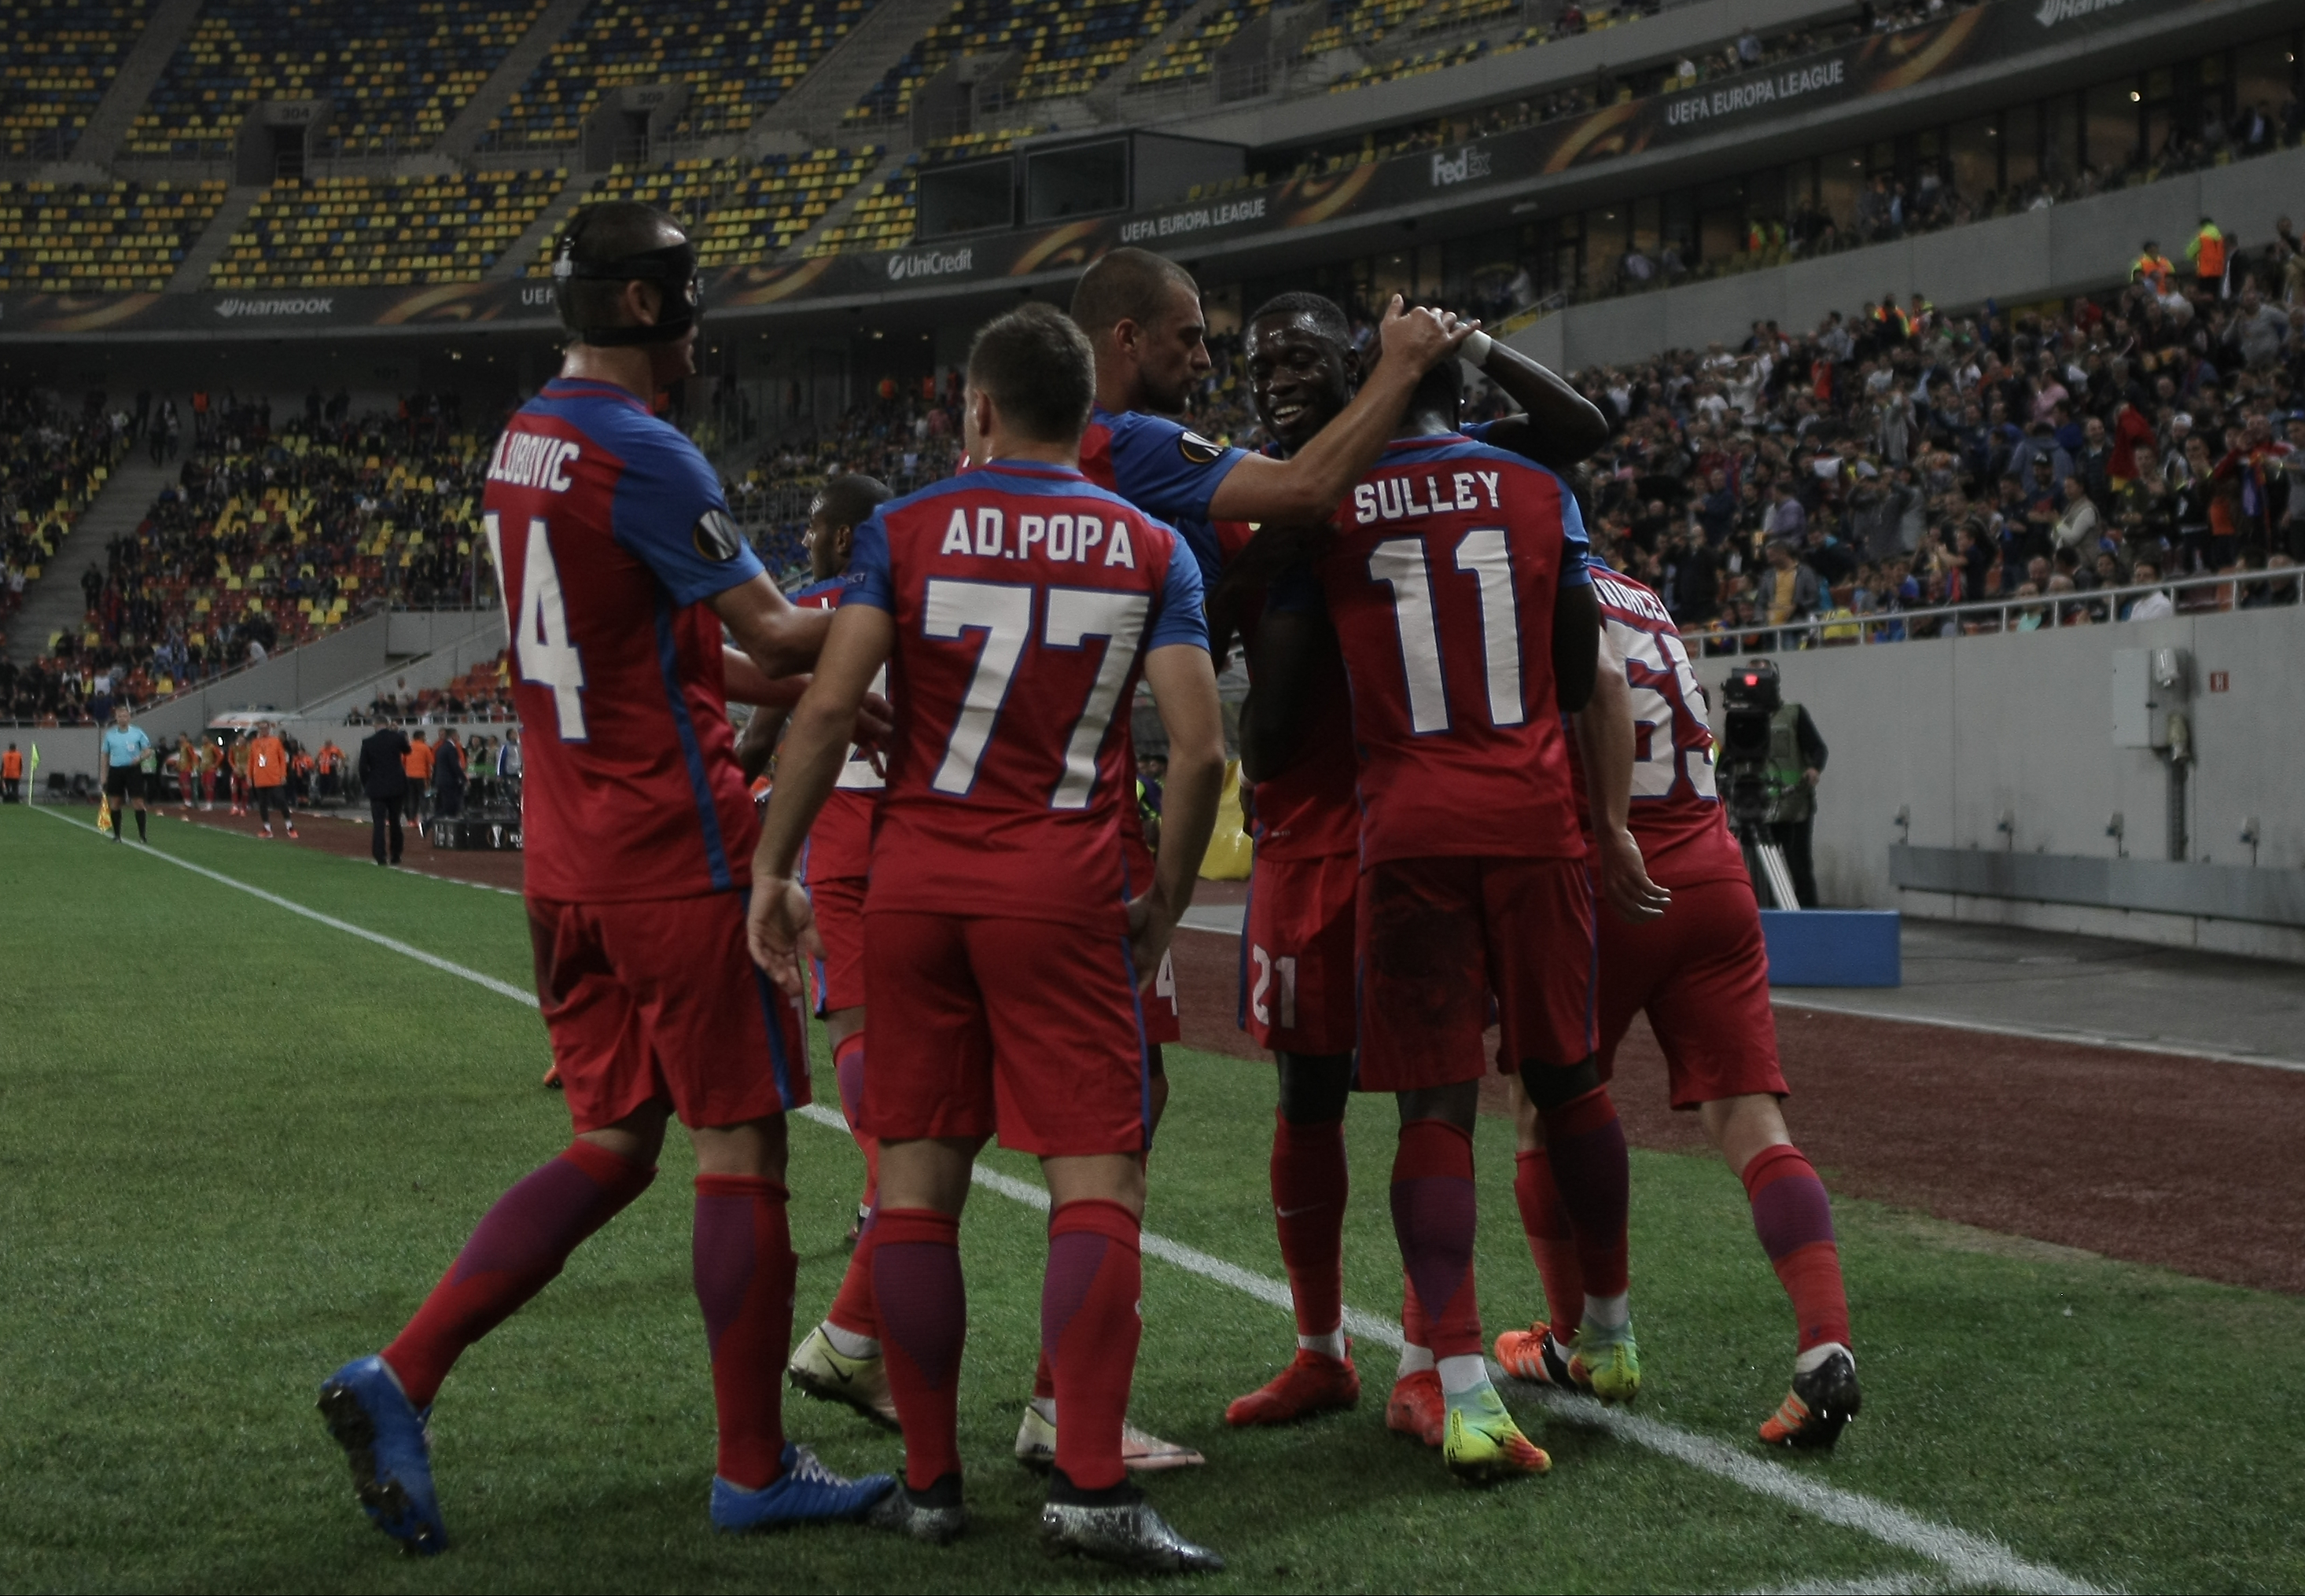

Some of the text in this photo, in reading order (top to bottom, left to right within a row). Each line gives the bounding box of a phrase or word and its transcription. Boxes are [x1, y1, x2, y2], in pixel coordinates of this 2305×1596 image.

[1667, 59, 1844, 126] UEFA EUROPA LEAGUE
[1432, 145, 1492, 186] FedEx
[1121, 197, 1267, 243] UEFA EUROPA LEAGUE
[907, 248, 973, 278] UniCredit
[521, 287, 555, 306] UEF
[486, 429, 580, 493] LUBOVIC
[1356, 471, 1501, 524] SULLEY
[941, 507, 1135, 569] AD.POPA
[1368, 528, 1525, 734] 11
[925, 579, 1151, 809] 77
[1252, 943, 1295, 1029] 21
